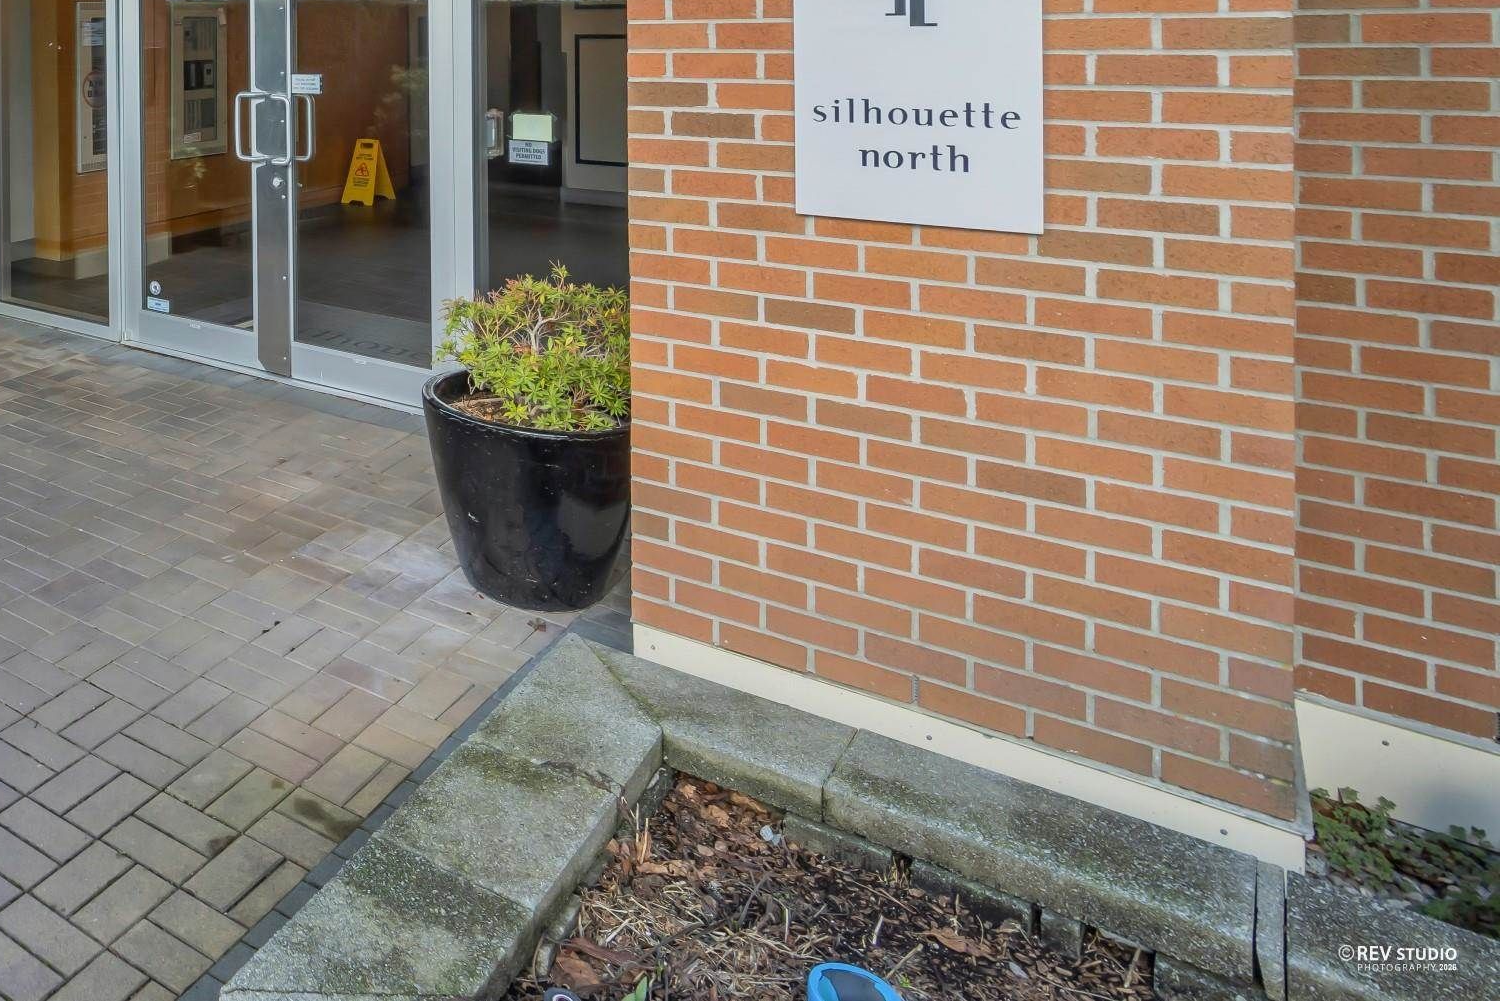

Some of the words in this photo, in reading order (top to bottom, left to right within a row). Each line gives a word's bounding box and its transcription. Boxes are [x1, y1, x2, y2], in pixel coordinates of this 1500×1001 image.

[812, 98, 1021, 130] silhouette
[515, 152, 542, 160] PERMITTED
[858, 145, 969, 173] north
